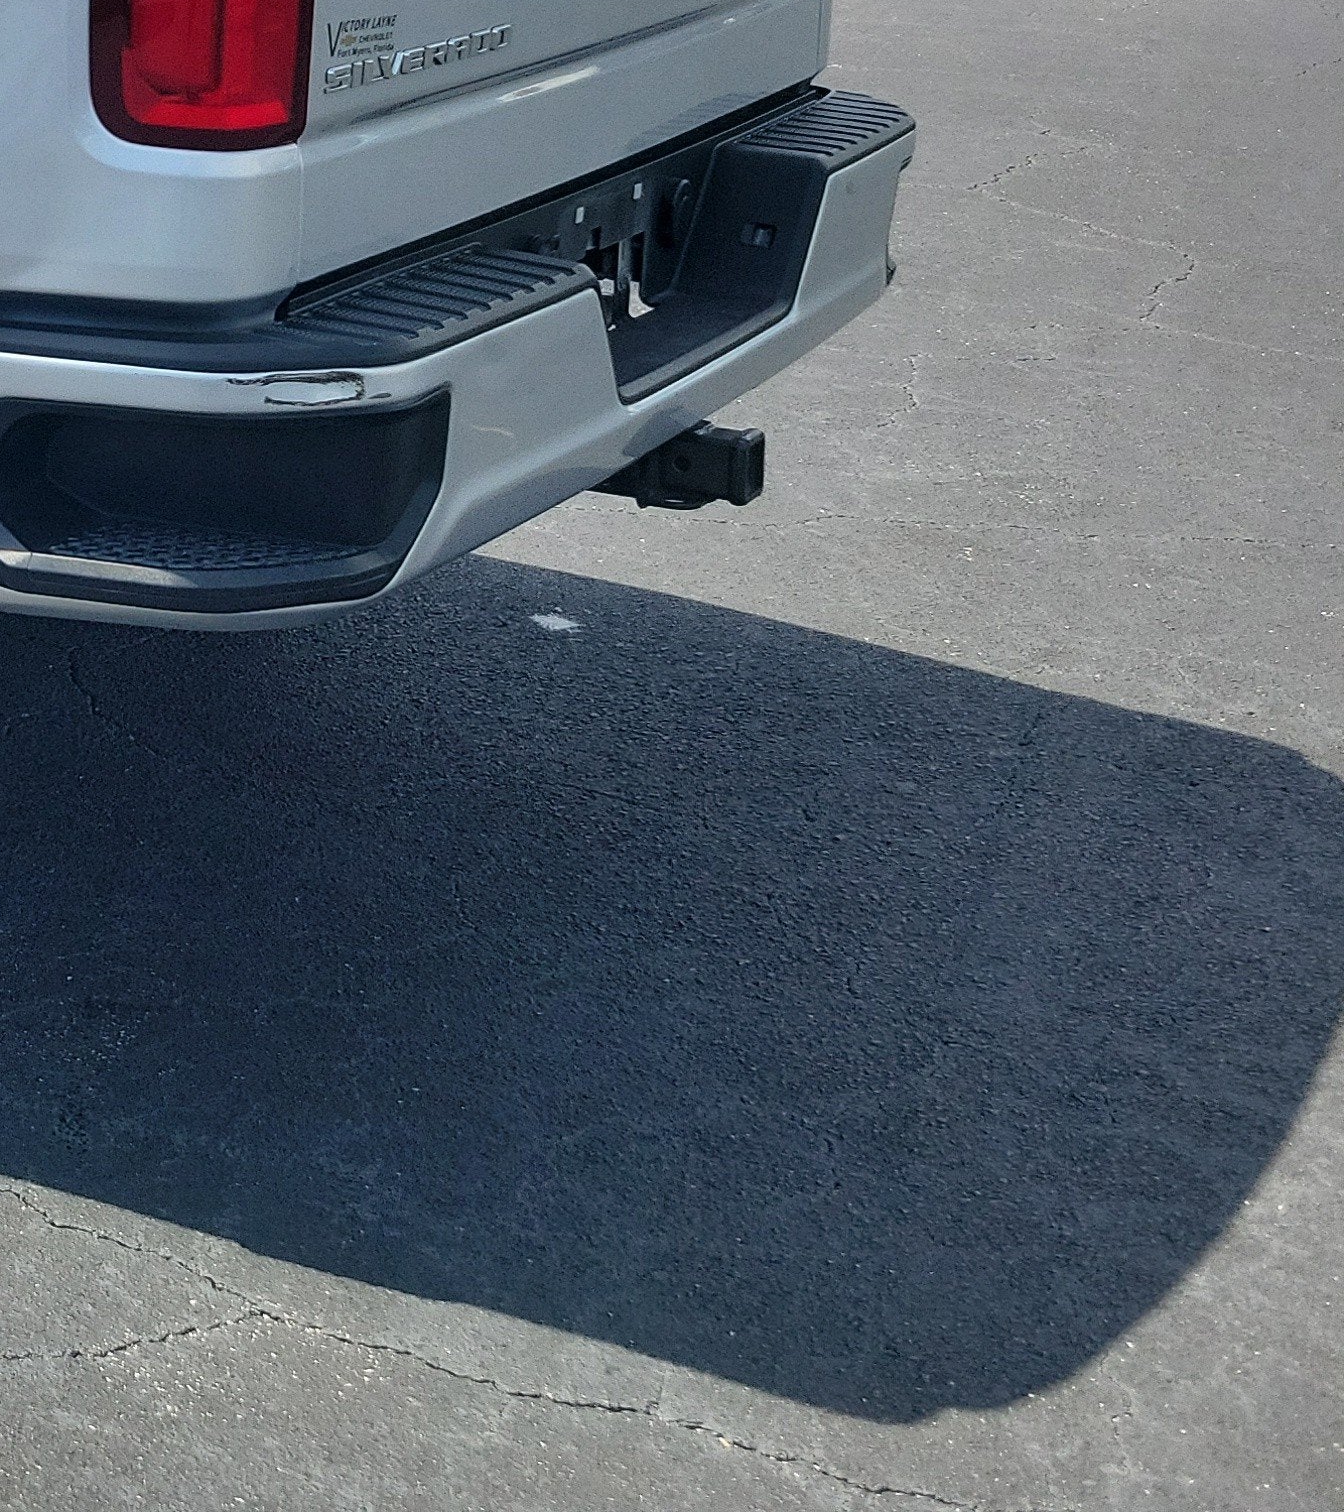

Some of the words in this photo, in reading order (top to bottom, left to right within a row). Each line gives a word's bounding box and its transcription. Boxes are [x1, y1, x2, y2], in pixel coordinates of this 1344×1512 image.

[323, 23, 512, 94] SILVERADO
[327, 17, 371, 57] VICTORY
[371, 14, 397, 29] LAYNE
